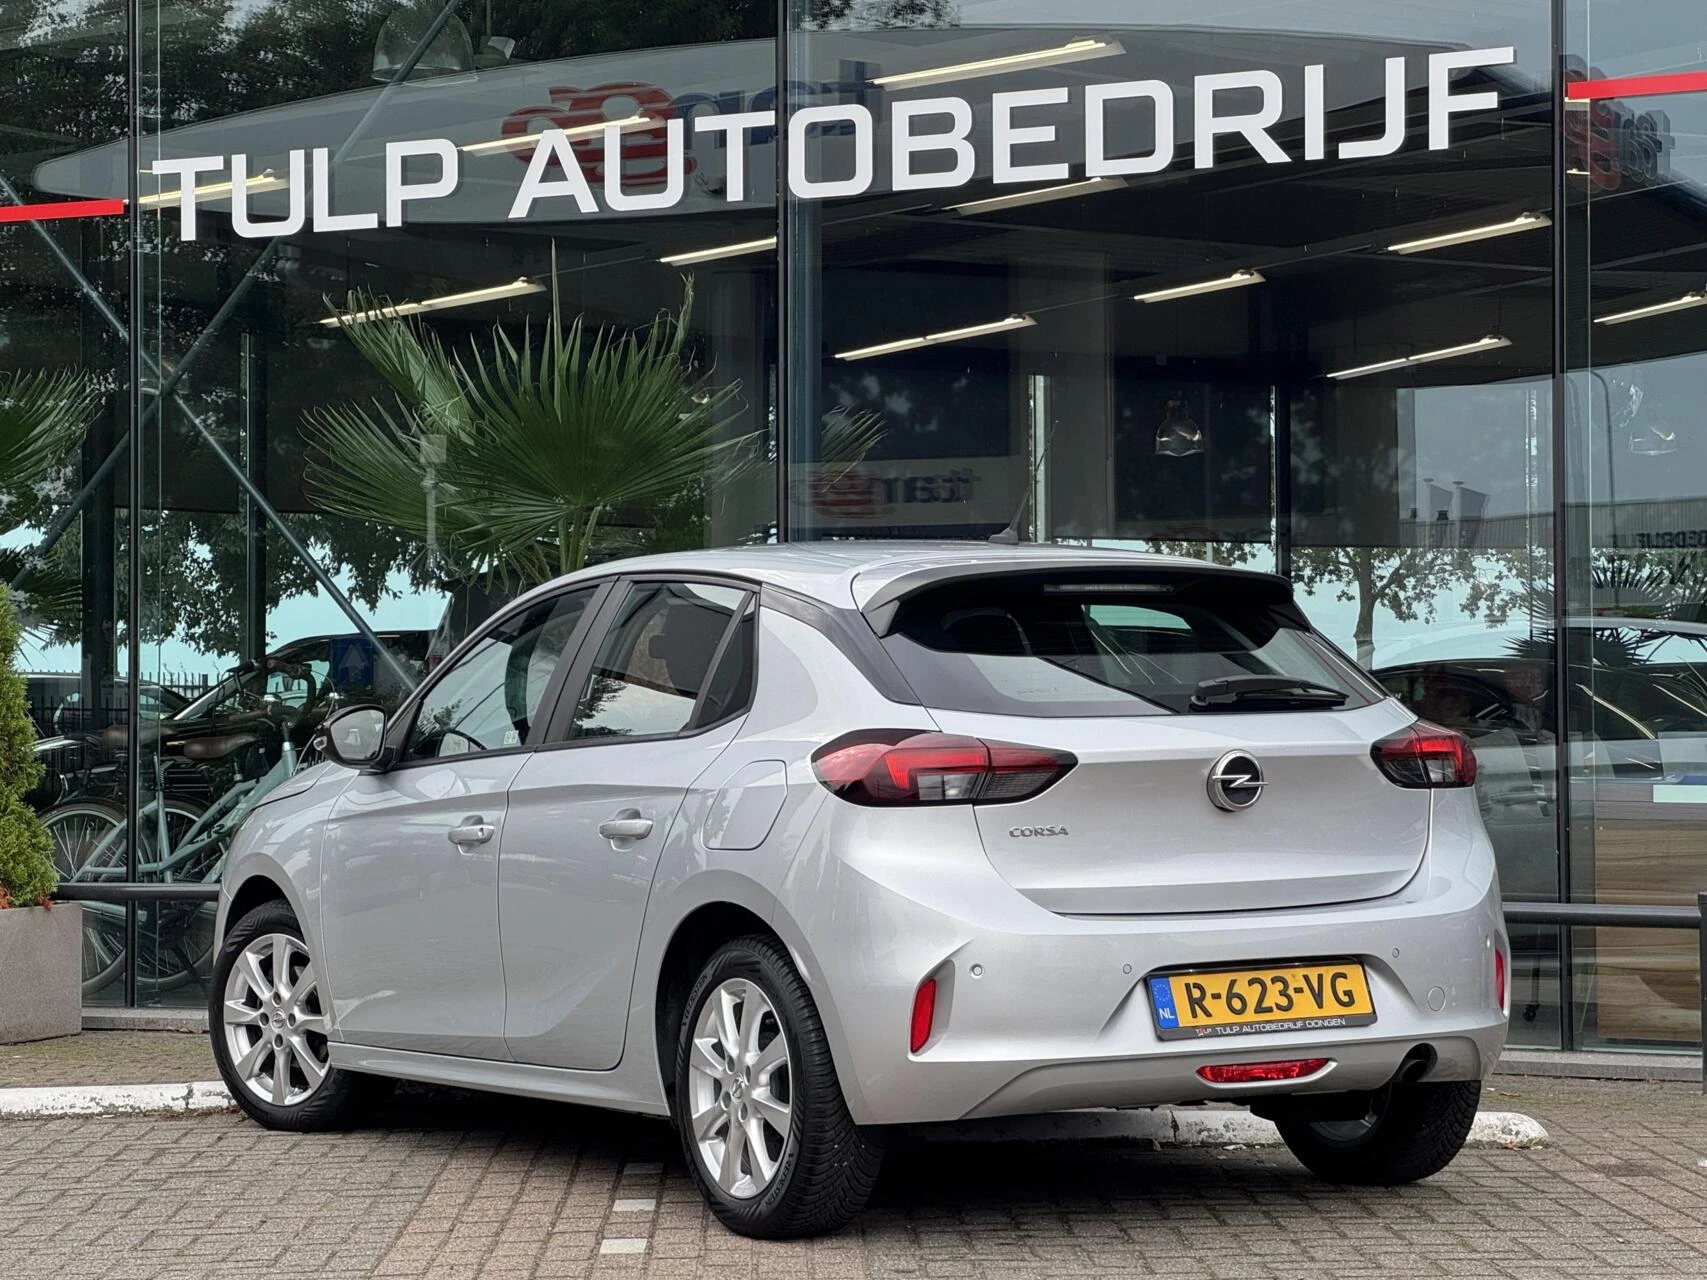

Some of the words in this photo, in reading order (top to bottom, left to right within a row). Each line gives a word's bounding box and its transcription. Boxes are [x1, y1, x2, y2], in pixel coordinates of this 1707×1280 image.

[152, 138, 460, 242] TULP
[508, 47, 1515, 220] AUTOBEDRIJF
[1008, 824, 1070, 838] CORSA
[1184, 972, 1356, 1019] R-623-VG
[1159, 1008, 1175, 1019] NL
[1215, 1026, 1240, 1035] TULP
[1242, 1019, 1304, 1033] AUTOBEDRIJF
[1305, 1017, 1346, 1029] DONGEN
